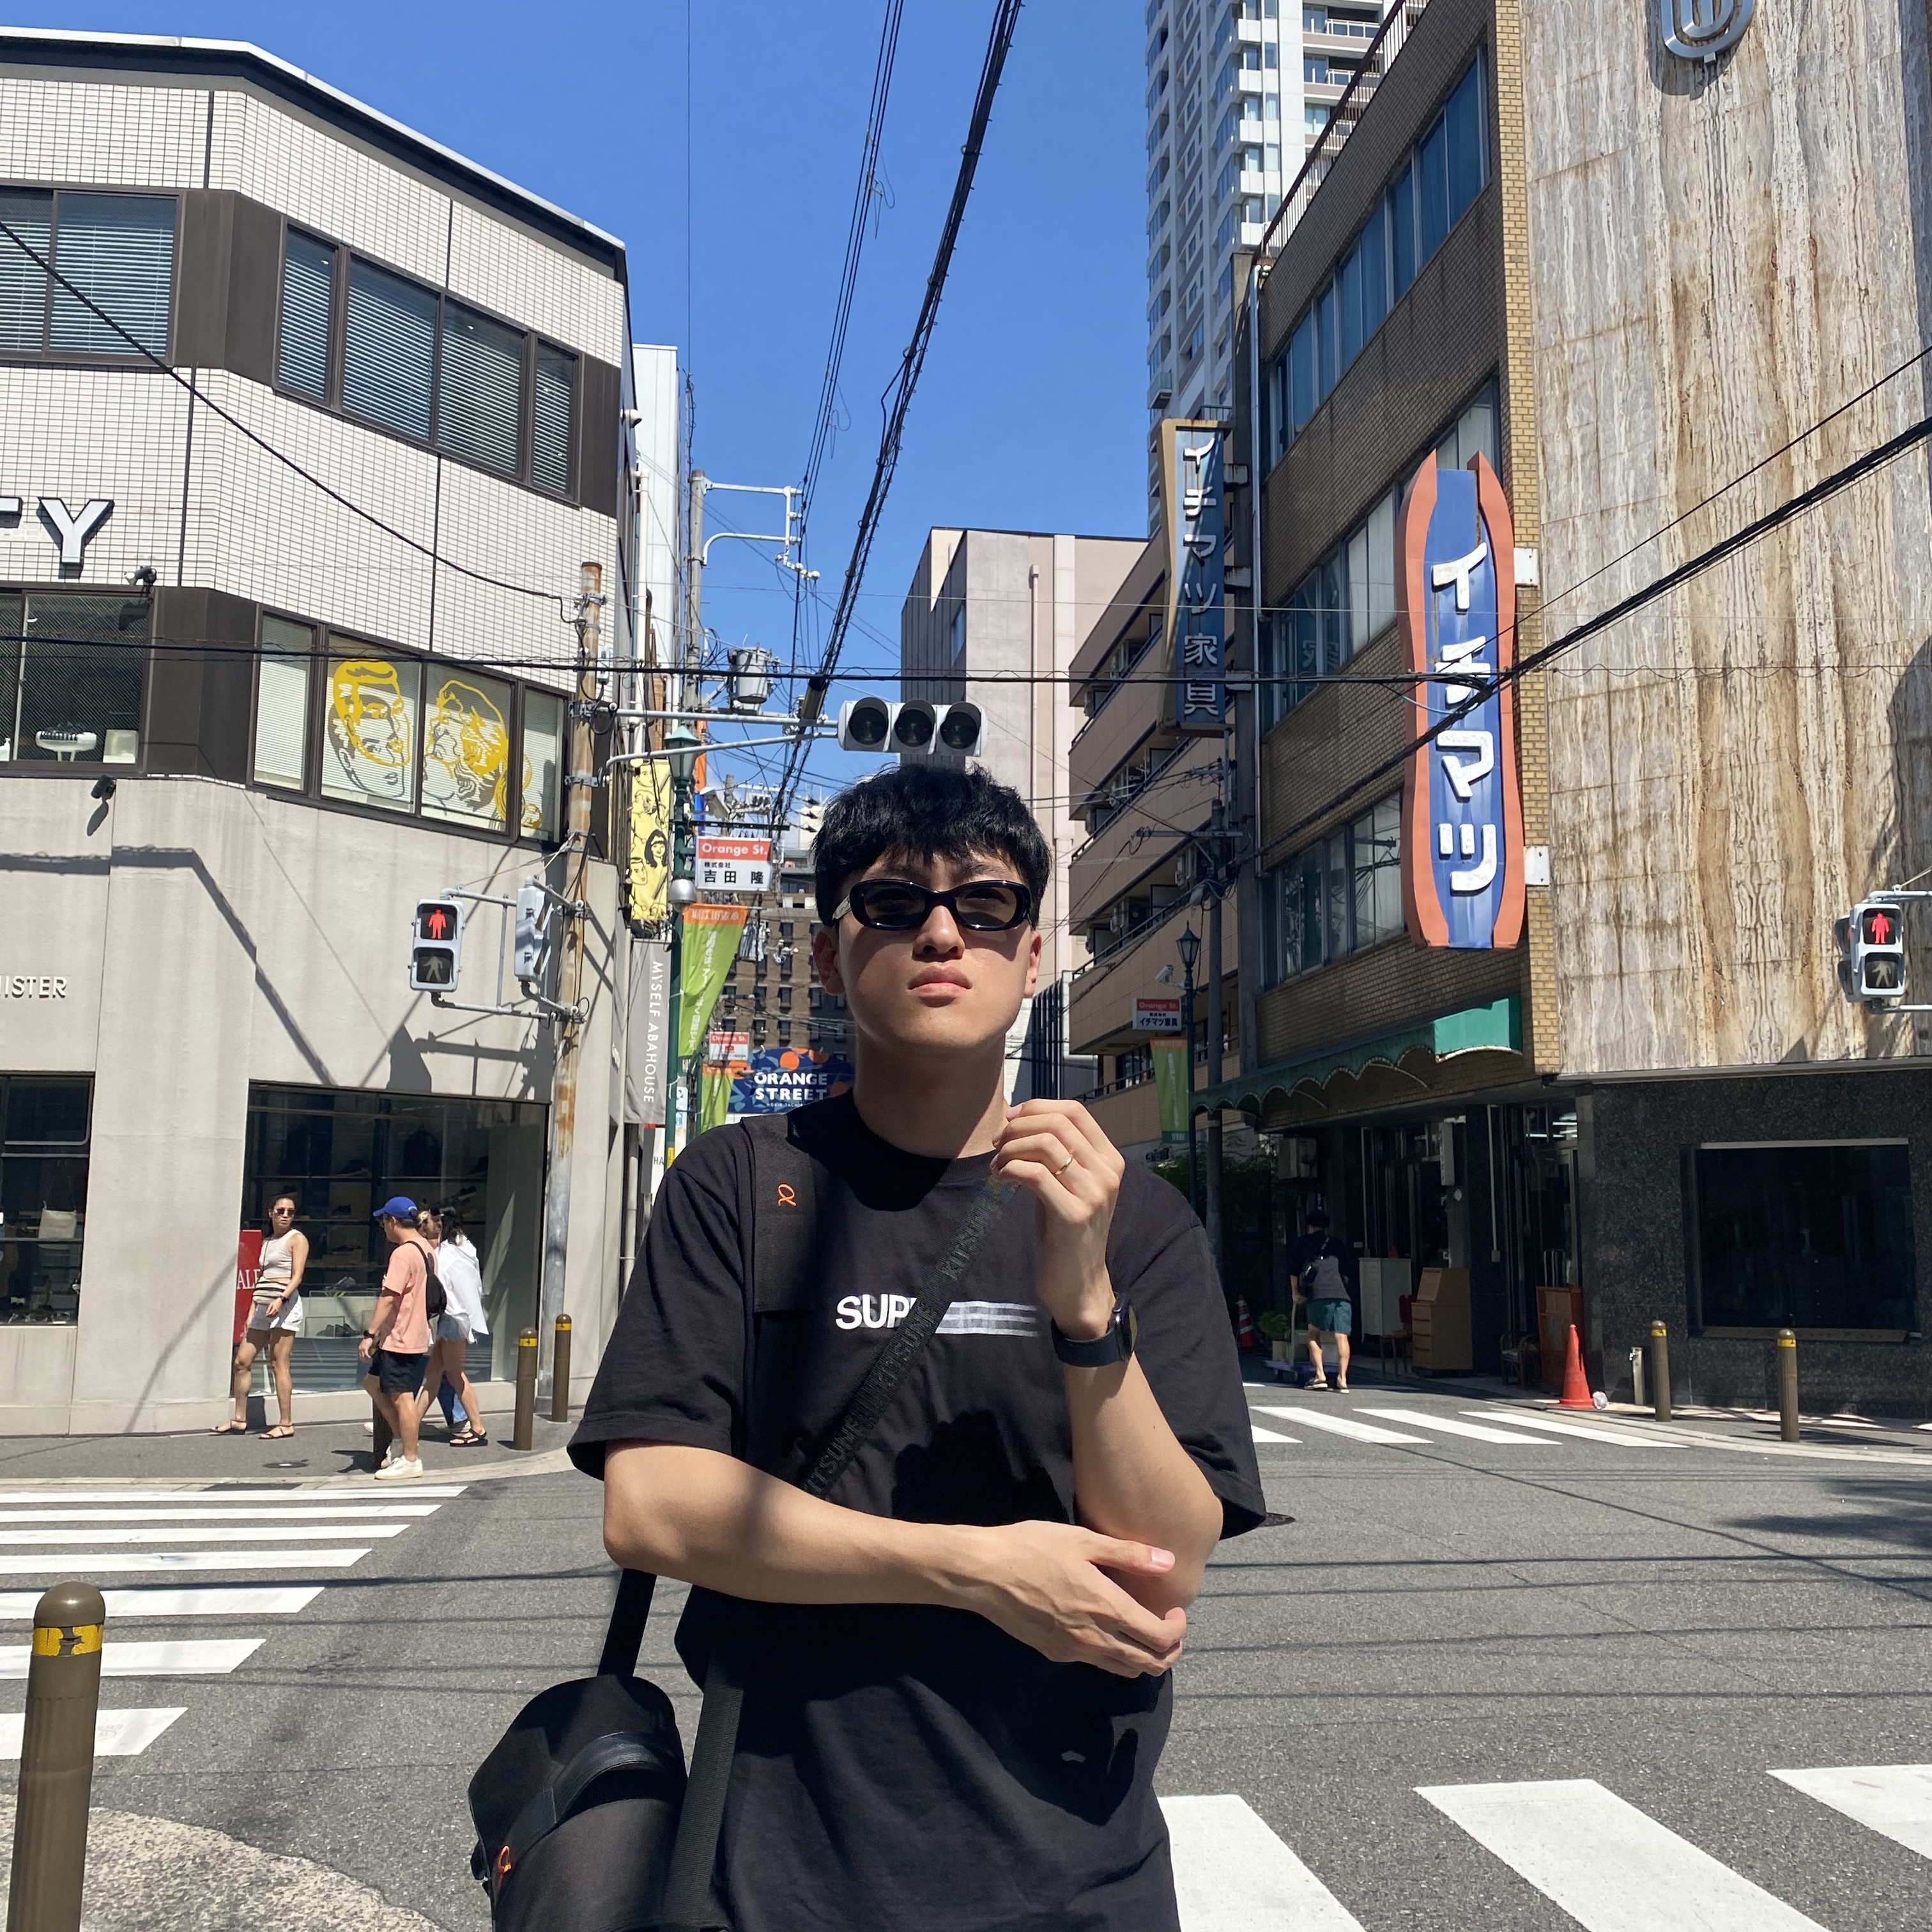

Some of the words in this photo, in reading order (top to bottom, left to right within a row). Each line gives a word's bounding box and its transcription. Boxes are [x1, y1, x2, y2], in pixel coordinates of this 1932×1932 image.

[1183, 436, 1218, 716] イチマツ家具
[1432, 542, 1497, 891] イチマツ
[702, 843, 749, 857] Orange
[753, 845, 768, 855] St.
[0, 975, 67, 999] ISTER
[649, 961, 664, 1017] MYSELF
[1139, 1002, 1167, 1010] Orange
[1139, 1018, 1177, 1027] イチマツ家具
[643, 1022, 659, 1103] ABAHOUSE
[754, 1072, 827, 1085] ORANGE
[755, 1087, 827, 1100] STREET
[835, 1293, 917, 1330] SUP
